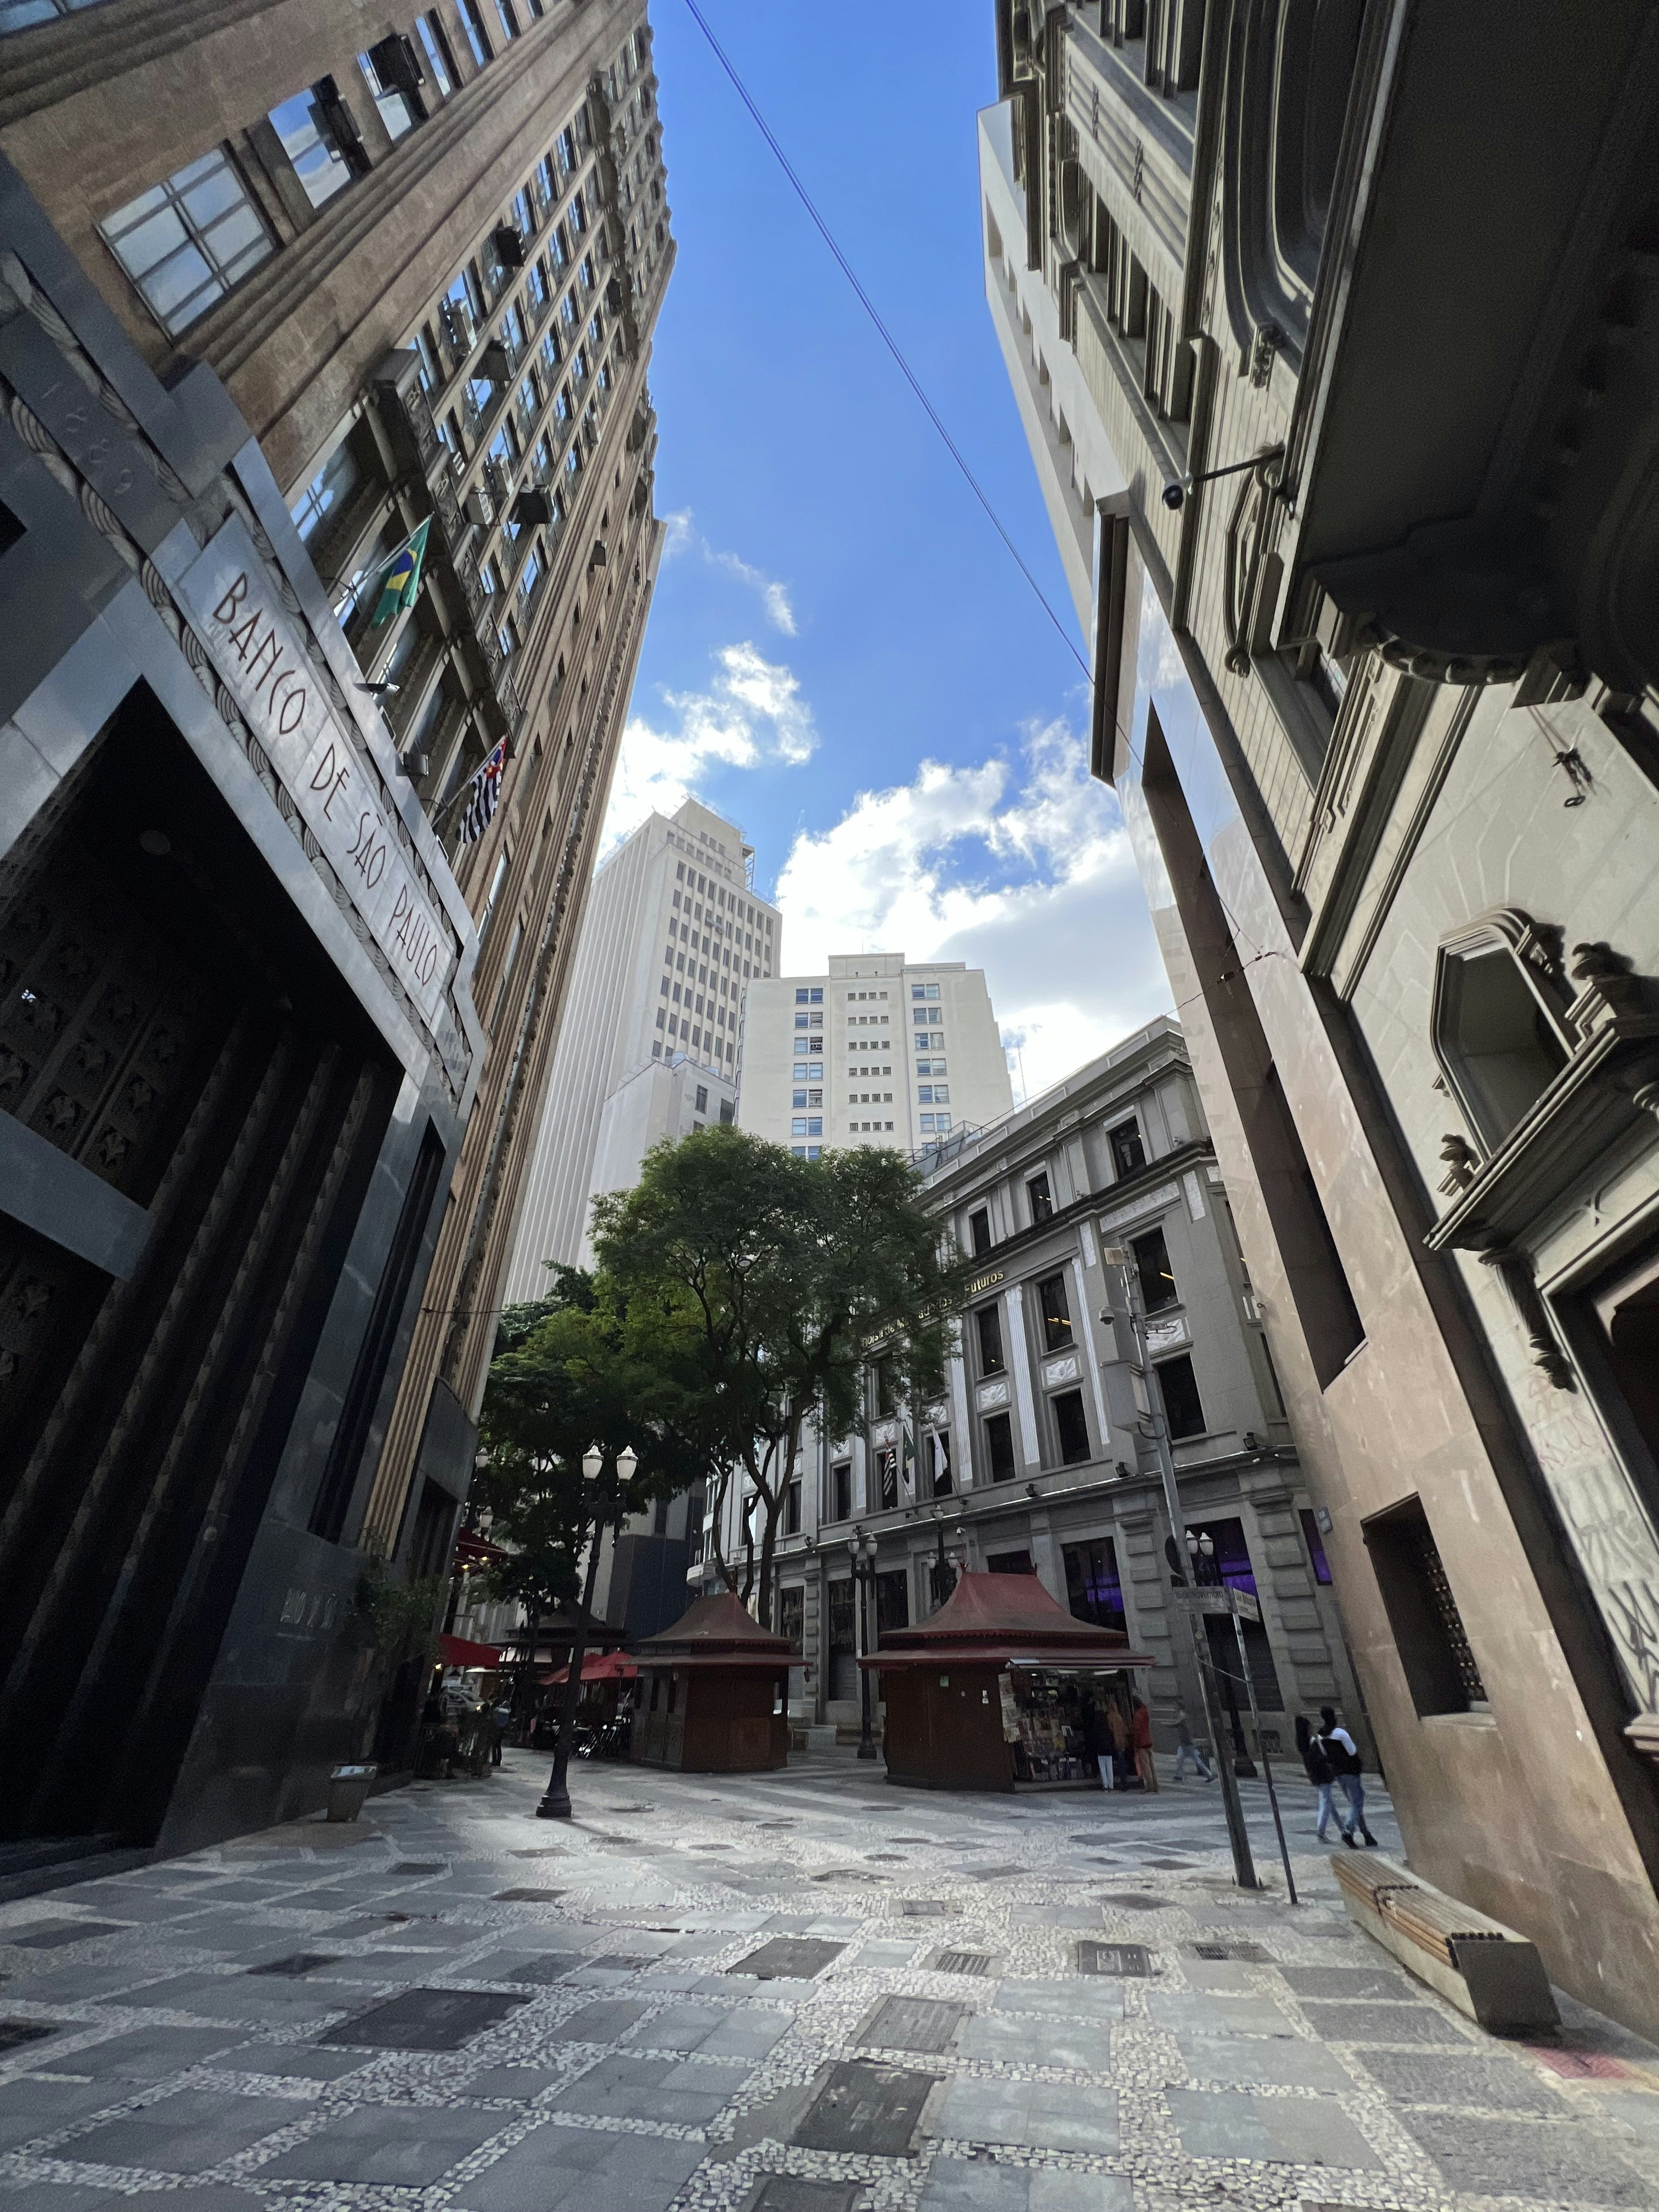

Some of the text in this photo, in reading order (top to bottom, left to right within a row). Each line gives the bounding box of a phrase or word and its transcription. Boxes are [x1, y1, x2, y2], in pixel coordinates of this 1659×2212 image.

[212, 571, 437, 987] BANCO DE SÃO PAULO
[964, 1269, 1003, 1294] Futuros
